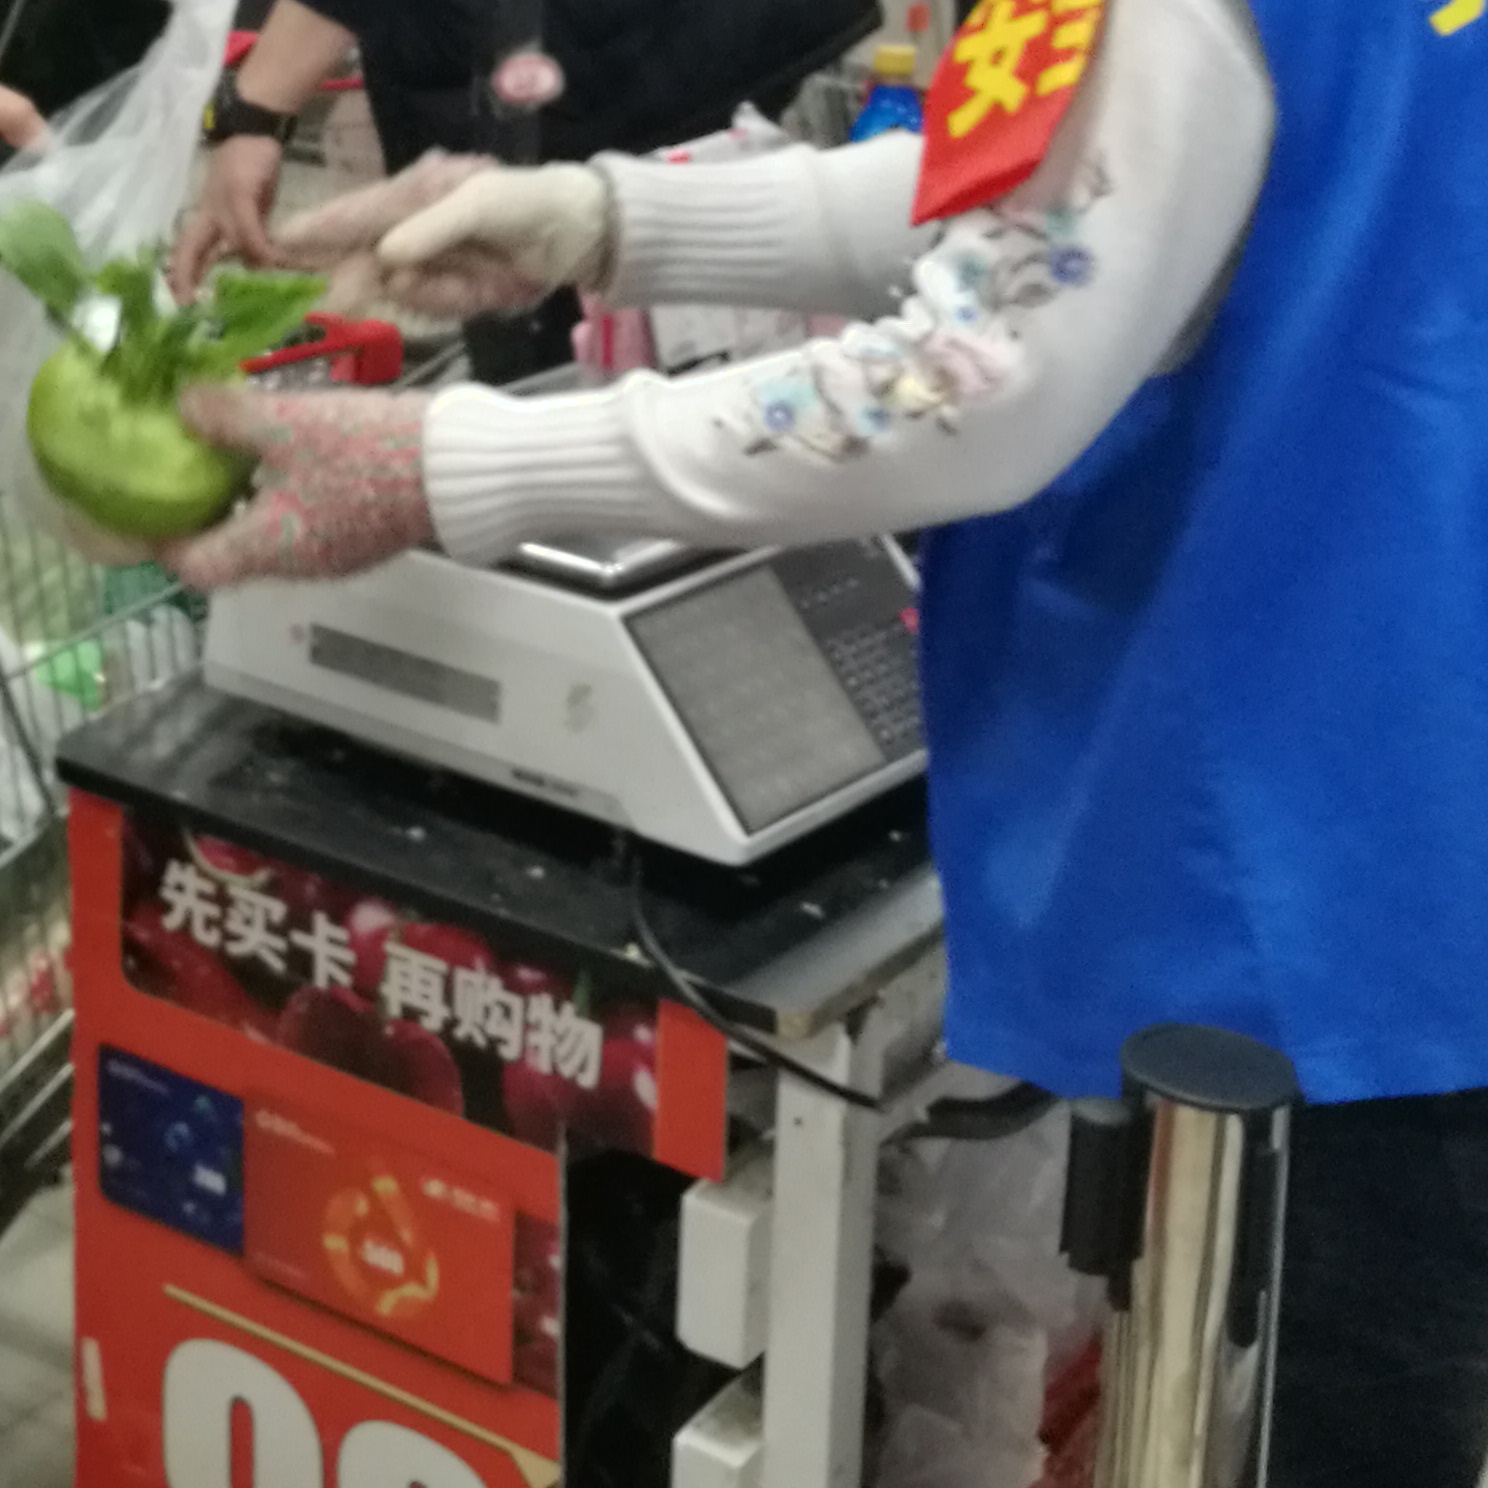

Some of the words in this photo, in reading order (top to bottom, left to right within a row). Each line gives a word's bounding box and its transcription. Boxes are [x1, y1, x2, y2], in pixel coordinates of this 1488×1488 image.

[158, 858, 357, 990] 先买卡
[381, 938, 603, 1090] 再购物
